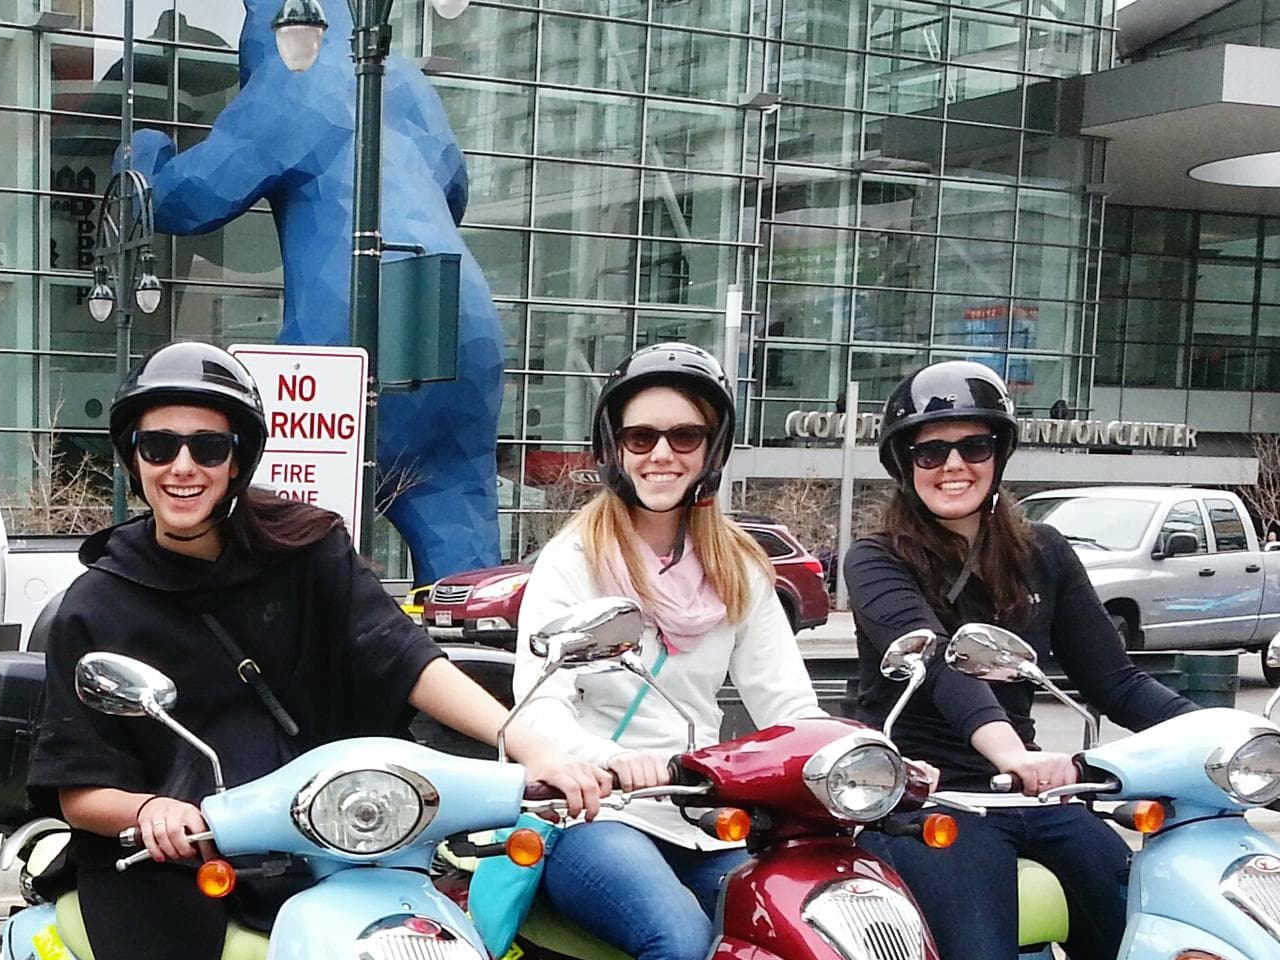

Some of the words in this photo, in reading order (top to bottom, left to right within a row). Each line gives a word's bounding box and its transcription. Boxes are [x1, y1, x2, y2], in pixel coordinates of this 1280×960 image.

[278, 374, 317, 402] NO
[267, 411, 355, 440] RKING
[785, 410, 883, 438] COLOR
[1017, 418, 1107, 445] ENTION
[1108, 420, 1197, 448] CENTER
[271, 464, 317, 483] FIRE
[274, 490, 320, 504] ONE
